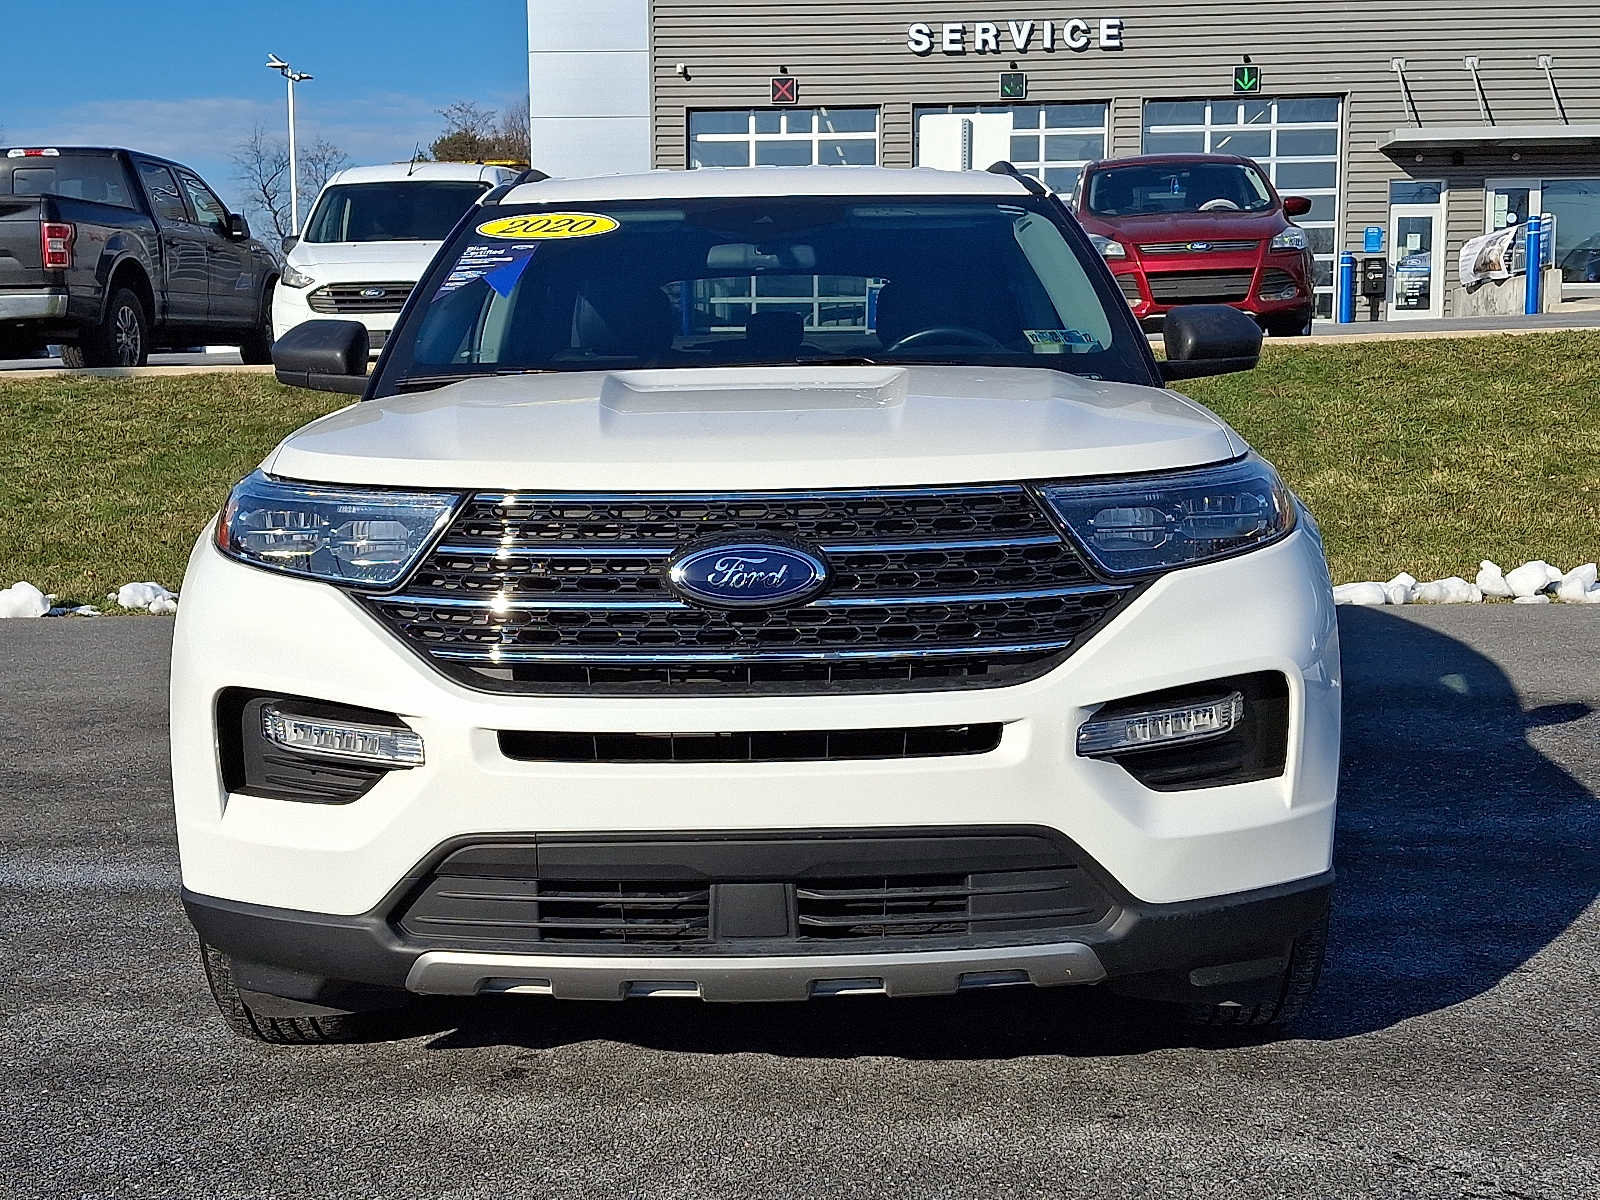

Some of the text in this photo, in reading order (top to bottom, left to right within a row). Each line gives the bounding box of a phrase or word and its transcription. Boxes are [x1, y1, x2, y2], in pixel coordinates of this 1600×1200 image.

[907, 18, 1123, 56] SERVICE
[496, 218, 597, 234] 2020
[707, 556, 789, 589] Ford
